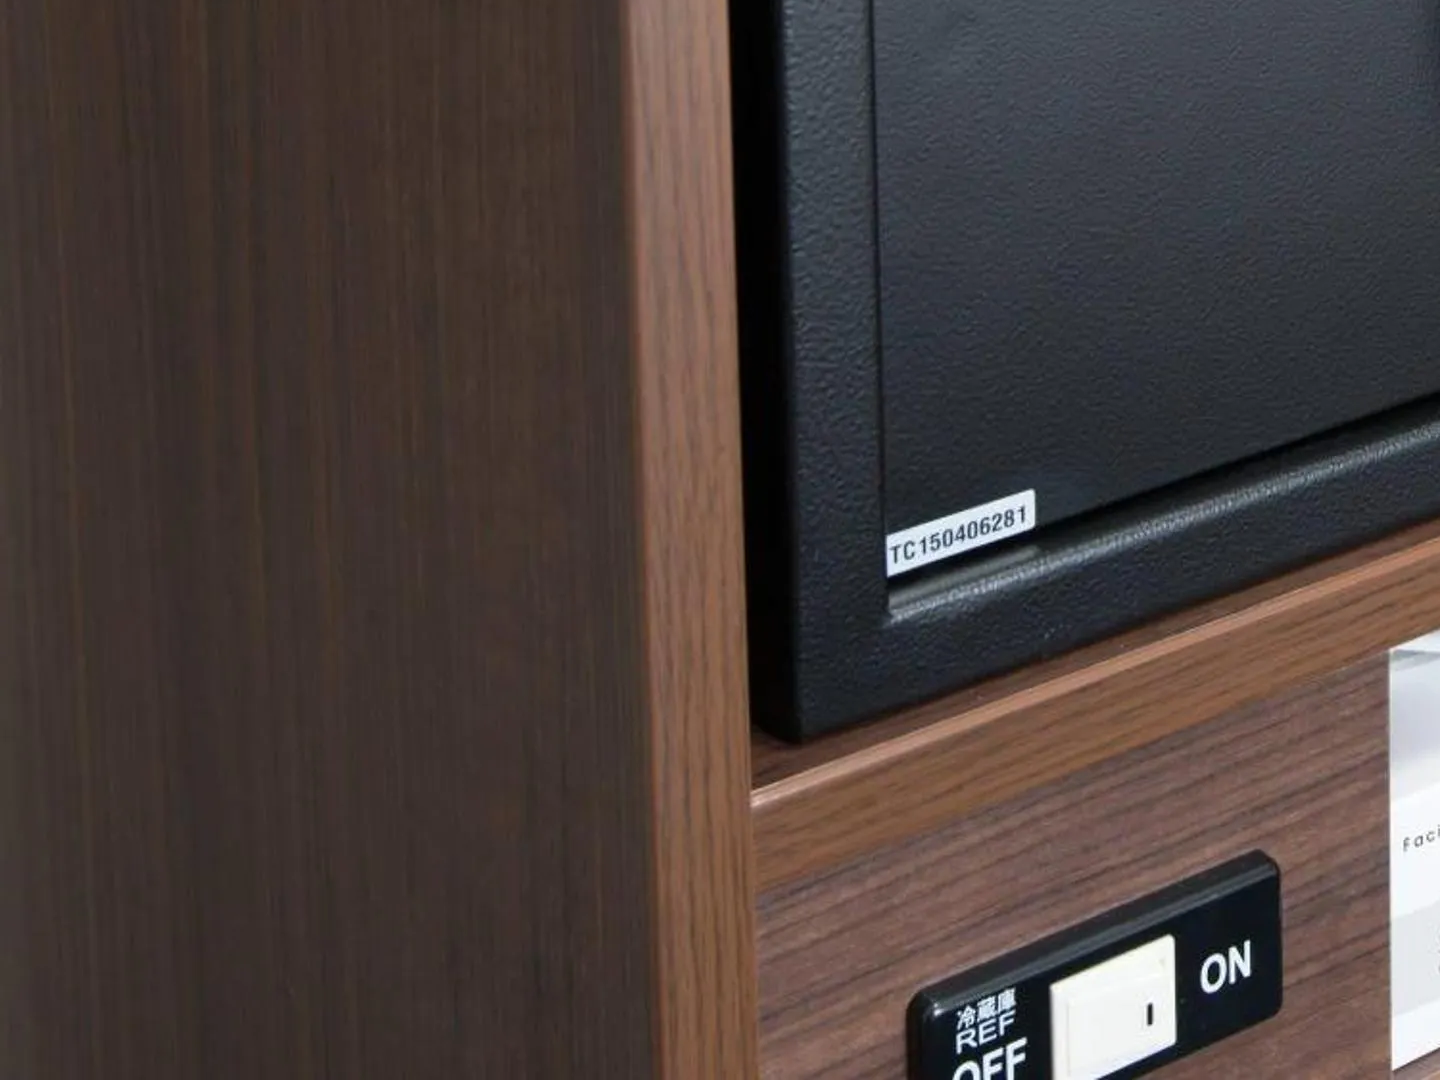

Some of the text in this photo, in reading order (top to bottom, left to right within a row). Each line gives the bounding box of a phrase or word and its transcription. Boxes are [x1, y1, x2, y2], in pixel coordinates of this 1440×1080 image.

[889, 503, 1027, 565] TC150406281
[1200, 939, 1252, 995] ON
[955, 1009, 1017, 1055] REF
